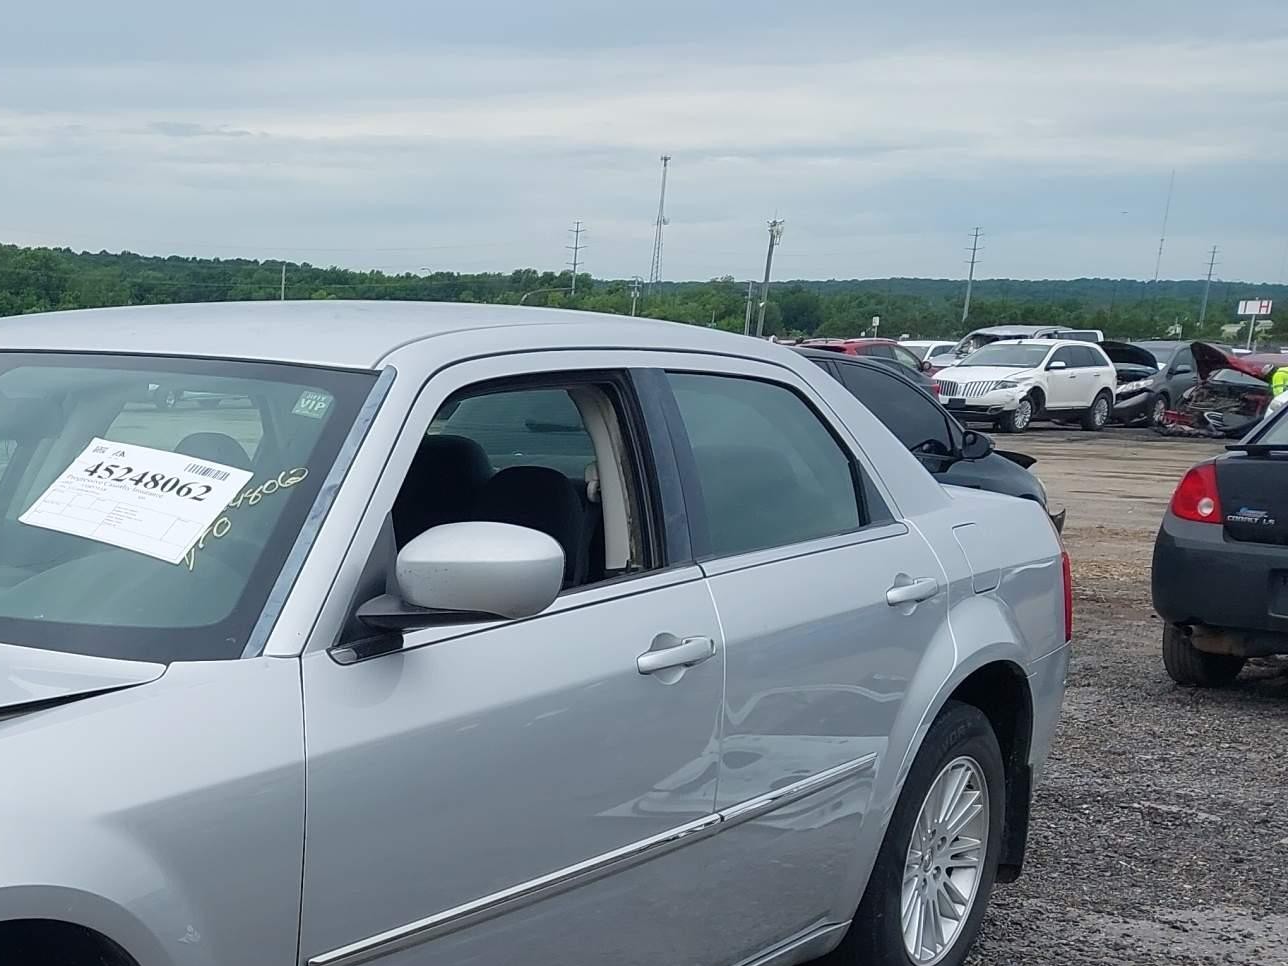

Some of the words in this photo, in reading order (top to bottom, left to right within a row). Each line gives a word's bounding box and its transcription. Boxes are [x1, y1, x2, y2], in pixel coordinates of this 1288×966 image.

[1258, 301, 1269, 313] H
[301, 398, 325, 410] VIP
[84, 461, 212, 501] 45248062
